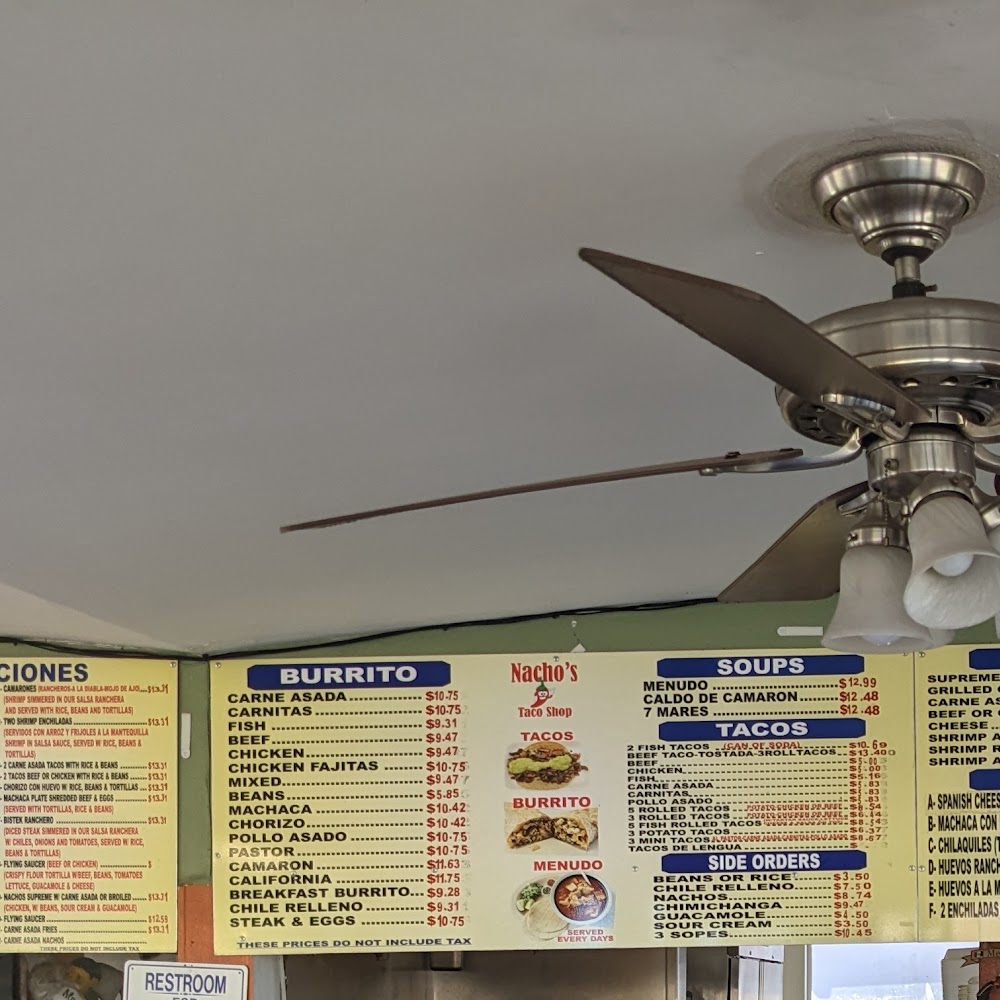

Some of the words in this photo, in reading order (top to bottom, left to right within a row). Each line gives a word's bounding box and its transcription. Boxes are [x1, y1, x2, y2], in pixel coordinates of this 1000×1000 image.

[717, 658, 804, 675] SOUPS
[280, 666, 417, 684] BURRITO
[511, 662, 578, 683] Nacho's
[928, 674, 1000, 682] SUPREME
[643, 680, 708, 691] MENUDO
[928, 685, 992, 694] GRILLED
[228, 693, 284, 703] CARNE
[291, 692, 347, 702] ASADA
[643, 694, 694, 704] CALDO
[699, 693, 718, 703] DE
[723, 691, 798, 703] CAMARON
[928, 697, 980, 706] CARNE
[228, 707, 312, 717] CARNITAS
[518, 707, 542, 718] Taco
[546, 707, 572, 718] Shop
[644, 708, 652, 717] 7
[657, 706, 708, 717] MARES
[928, 709, 967, 718] BEEF
[973, 709, 993, 717] OR
[228, 722, 266, 731] FISH
[716, 722, 808, 737] TACOS
[928, 721, 988, 730] CHEESE
[228, 735, 270, 745] BEEF
[521, 732, 573, 741] TACOS
[228, 749, 304, 759] CHICKEN
[229, 763, 304, 773] CHICKEN
[310, 761, 378, 772] FAJITAS
[229, 777, 282, 787] MIXED
[229, 791, 285, 801] BEANS
[938, 792, 972, 810] SPANISH
[513, 797, 591, 808] BURRITO
[229, 804, 312, 815] MACHACA
[229, 819, 305, 829] CHORIZO
[229, 833, 283, 843] POLLO
[289, 832, 347, 842] ASADO
[938, 836, 992, 854] CHILAQUILES
[229, 847, 294, 857] PASTOR
[229, 861, 314, 872] CAMARON
[534, 860, 603, 871] MENUDO
[708, 854, 747, 870] SIDE
[752, 853, 820, 870] ORDERS
[938, 859, 972, 875] HUEVOS
[230, 874, 332, 886] CALIFORNIA
[654, 875, 713, 883] BEANS
[230, 888, 329, 900] BREAKFAST
[335, 887, 410, 898] BURRITO
[230, 903, 280, 913] CHILE
[285, 902, 363, 912] RELLENO
[653, 902, 782, 911] CHIMICHANGA
[654, 911, 766, 920] GUACAMOLE
[230, 918, 285, 927] STEAK
[292, 917, 303, 926] &
[310, 916, 356, 926] EGGS
[710, 920, 771, 929] CREAM
[145, 972, 226, 994] RESTROOM
